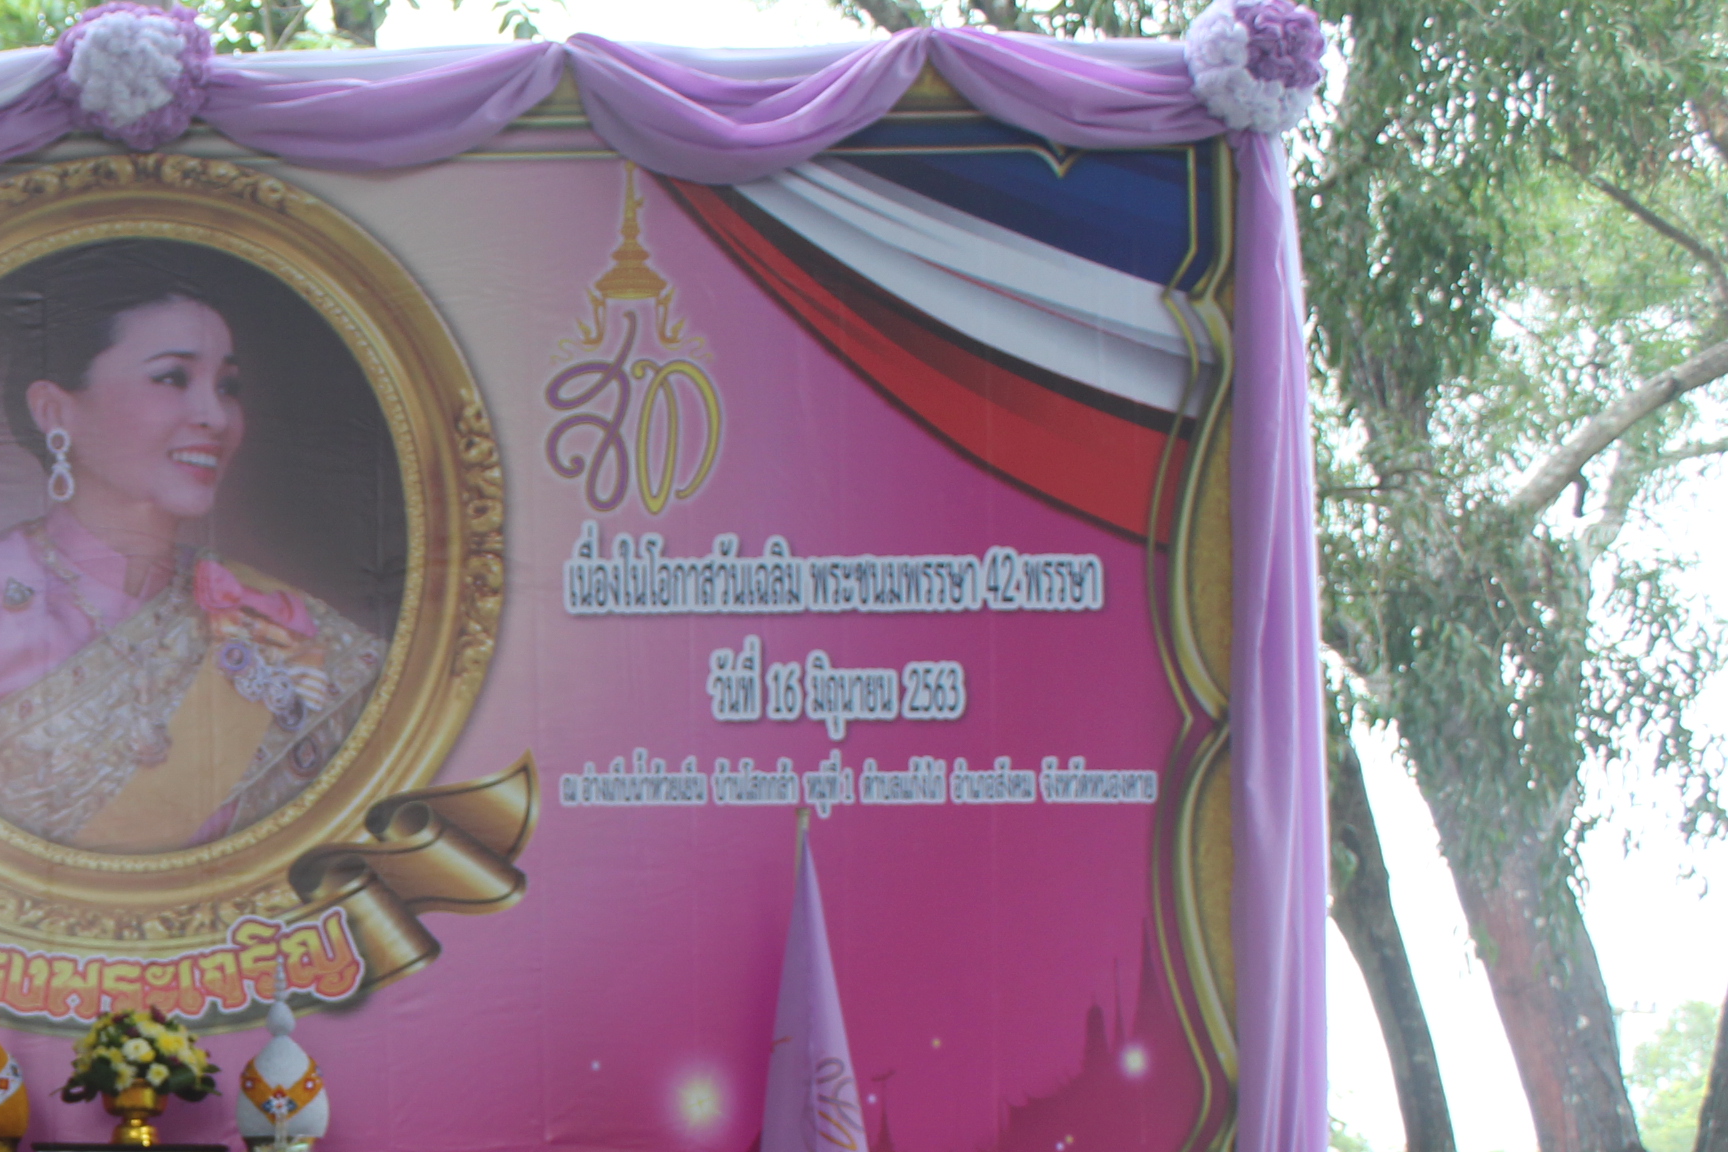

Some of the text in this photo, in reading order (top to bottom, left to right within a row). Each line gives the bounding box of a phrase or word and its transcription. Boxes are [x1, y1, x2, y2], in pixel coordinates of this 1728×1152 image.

[808, 557, 979, 607] พระชนมพรรษา
[984, 550, 1016, 606] 42
[1020, 557, 1101, 606] พรรษา
[711, 638, 963, 736] วันที่ 16 มิถุนายน 2563
